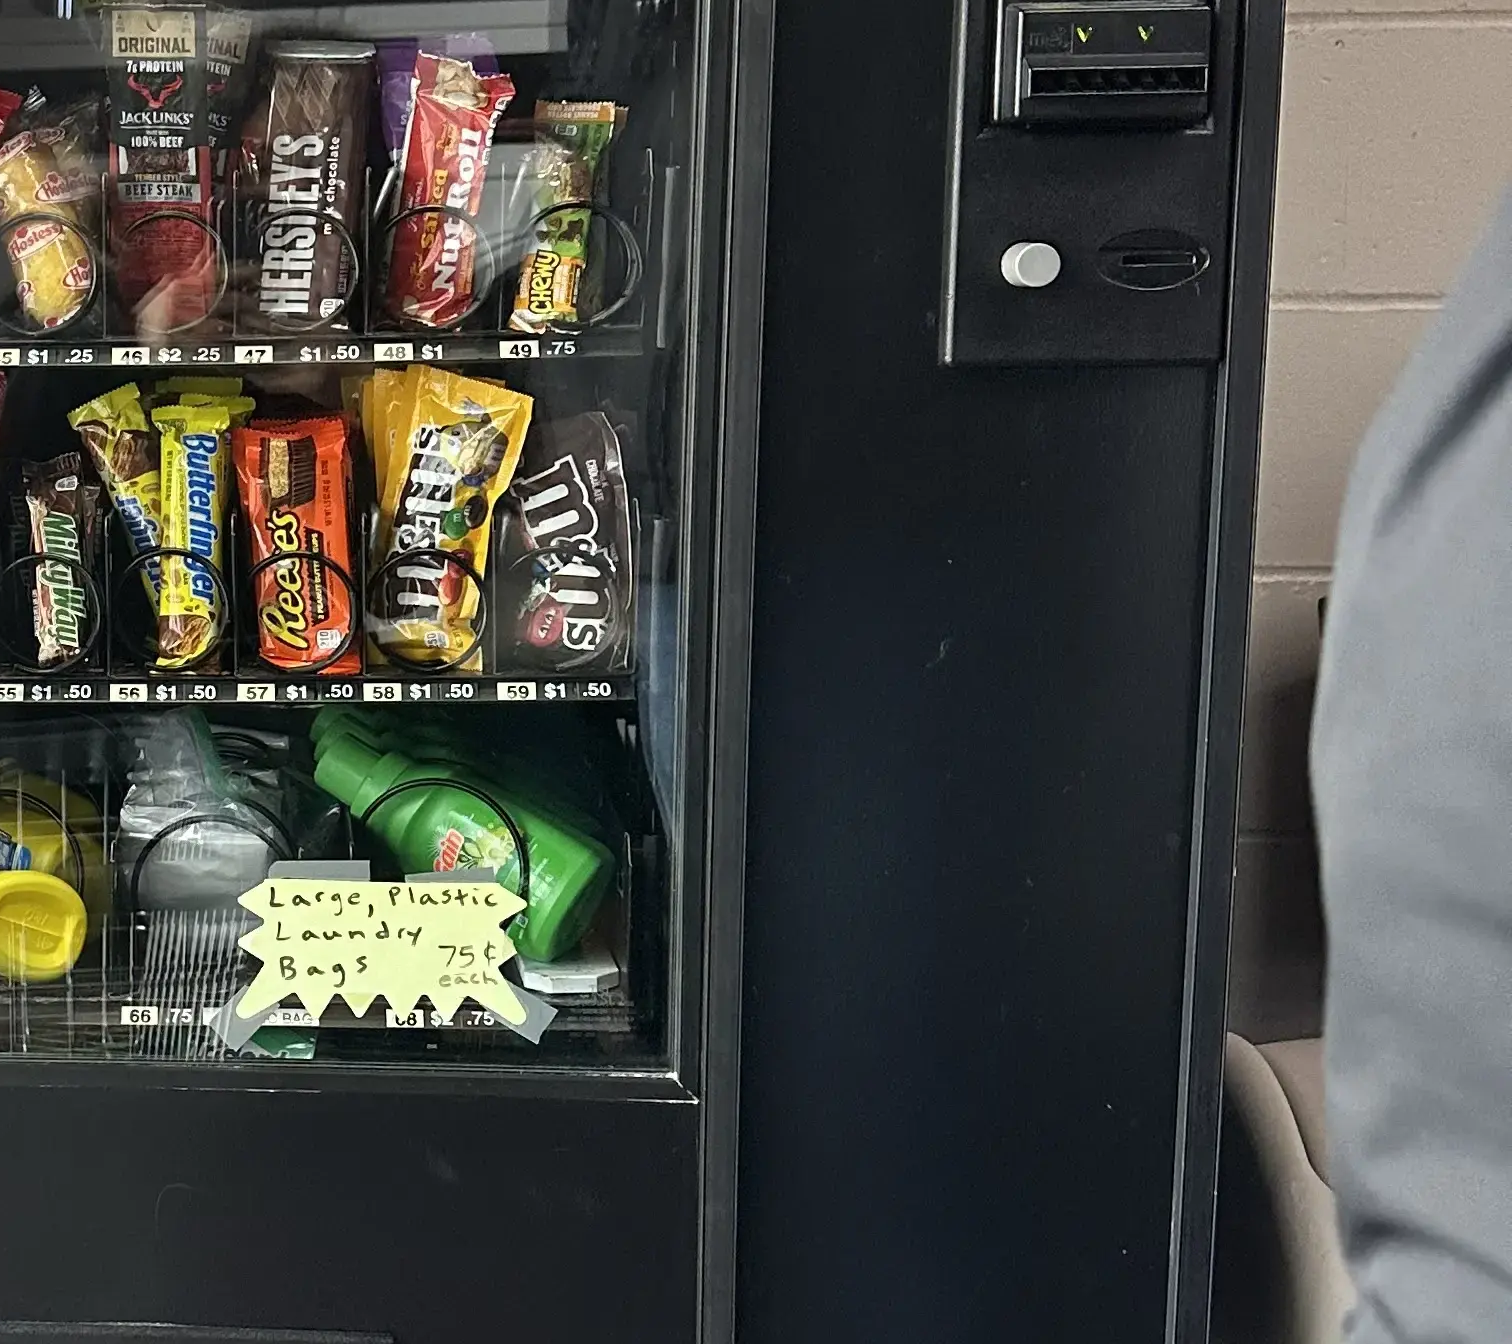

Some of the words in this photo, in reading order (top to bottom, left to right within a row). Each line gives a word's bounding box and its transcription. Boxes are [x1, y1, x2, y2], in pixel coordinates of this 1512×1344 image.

[118, 36, 191, 53] ORIGINAL
[139, 60, 184, 73] PROTEIN
[119, 110, 151, 126] JACK
[152, 110, 192, 125] LINK'S
[131, 135, 158, 148] 100%
[159, 136, 184, 148] BEEF
[325, 135, 341, 203] chocolate
[125, 184, 154, 197] BEEF
[156, 184, 193, 197] STEAK
[259, 134, 325, 313] HERSHEY'S
[9, 223, 62, 257] Hostess
[27, 349, 49, 365] $1
[65, 349, 94, 364] .25
[157, 348, 182, 364] $2
[192, 347, 221, 363] .25
[299, 345, 322, 363] $1
[330, 344, 360, 361] .50
[421, 344, 444, 361] $1
[509, 343, 532, 358] 49
[546, 341, 576, 356] .75
[181, 432, 220, 606] Butterfinger
[261, 508, 309, 650] Reese's
[31, 683, 53, 700] $1
[62, 684, 92, 699] .50
[117, 685, 141, 700] 56
[155, 683, 177, 700] $1
[187, 683, 217, 699] .50
[246, 685, 269, 700] 57
[286, 683, 308, 700] $1
[324, 683, 354, 699] .50
[372, 684, 395, 699] 58
[409, 682, 431, 699] $1
[444, 682, 474, 698] .50
[506, 684, 530, 699] 59
[544, 681, 567, 698] $1
[582, 681, 612, 698] .50
[268, 886, 376, 918] Large,
[388, 885, 498, 908] Plastic
[275, 921, 423, 947] Laundry
[278, 954, 370, 988] Bags
[437, 970, 498, 989] each
[129, 1009, 152, 1024] 66
